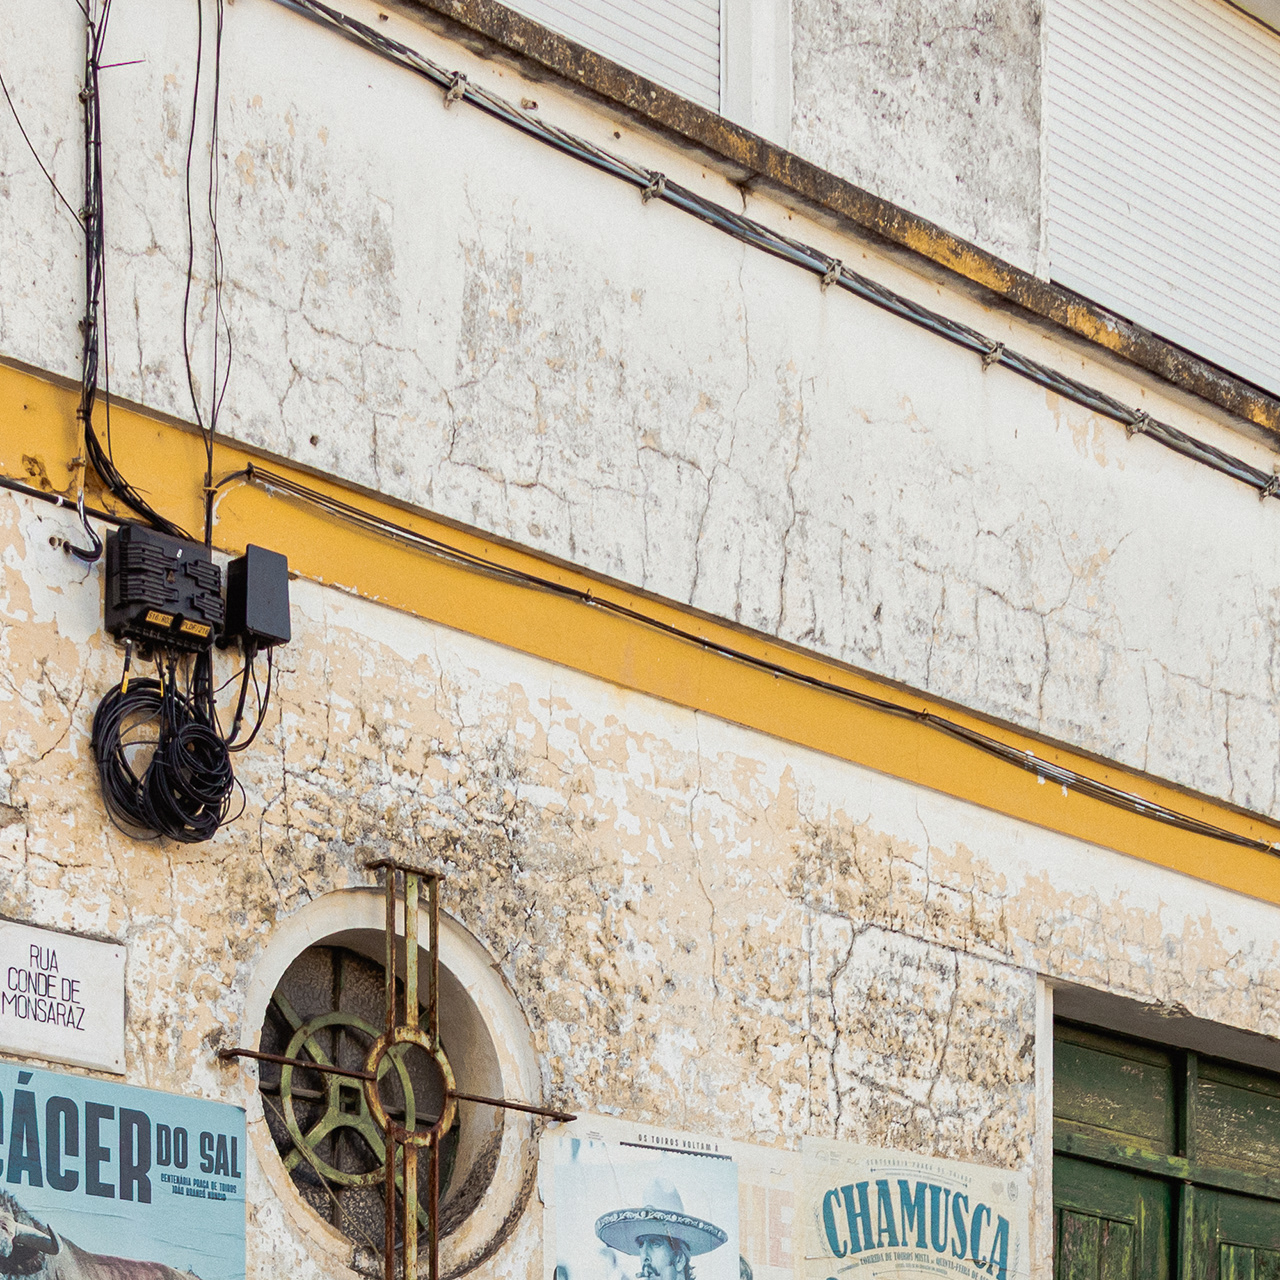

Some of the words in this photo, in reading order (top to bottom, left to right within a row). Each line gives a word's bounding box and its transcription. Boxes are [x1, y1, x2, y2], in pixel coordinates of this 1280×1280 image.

[29, 944, 59, 973] RUA
[8, 967, 56, 998] CONDE
[61, 978, 81, 1004] DE
[1, 991, 85, 1031] MONSARAZ
[156, 1123, 188, 1169] DO
[199, 1131, 241, 1178] SAL
